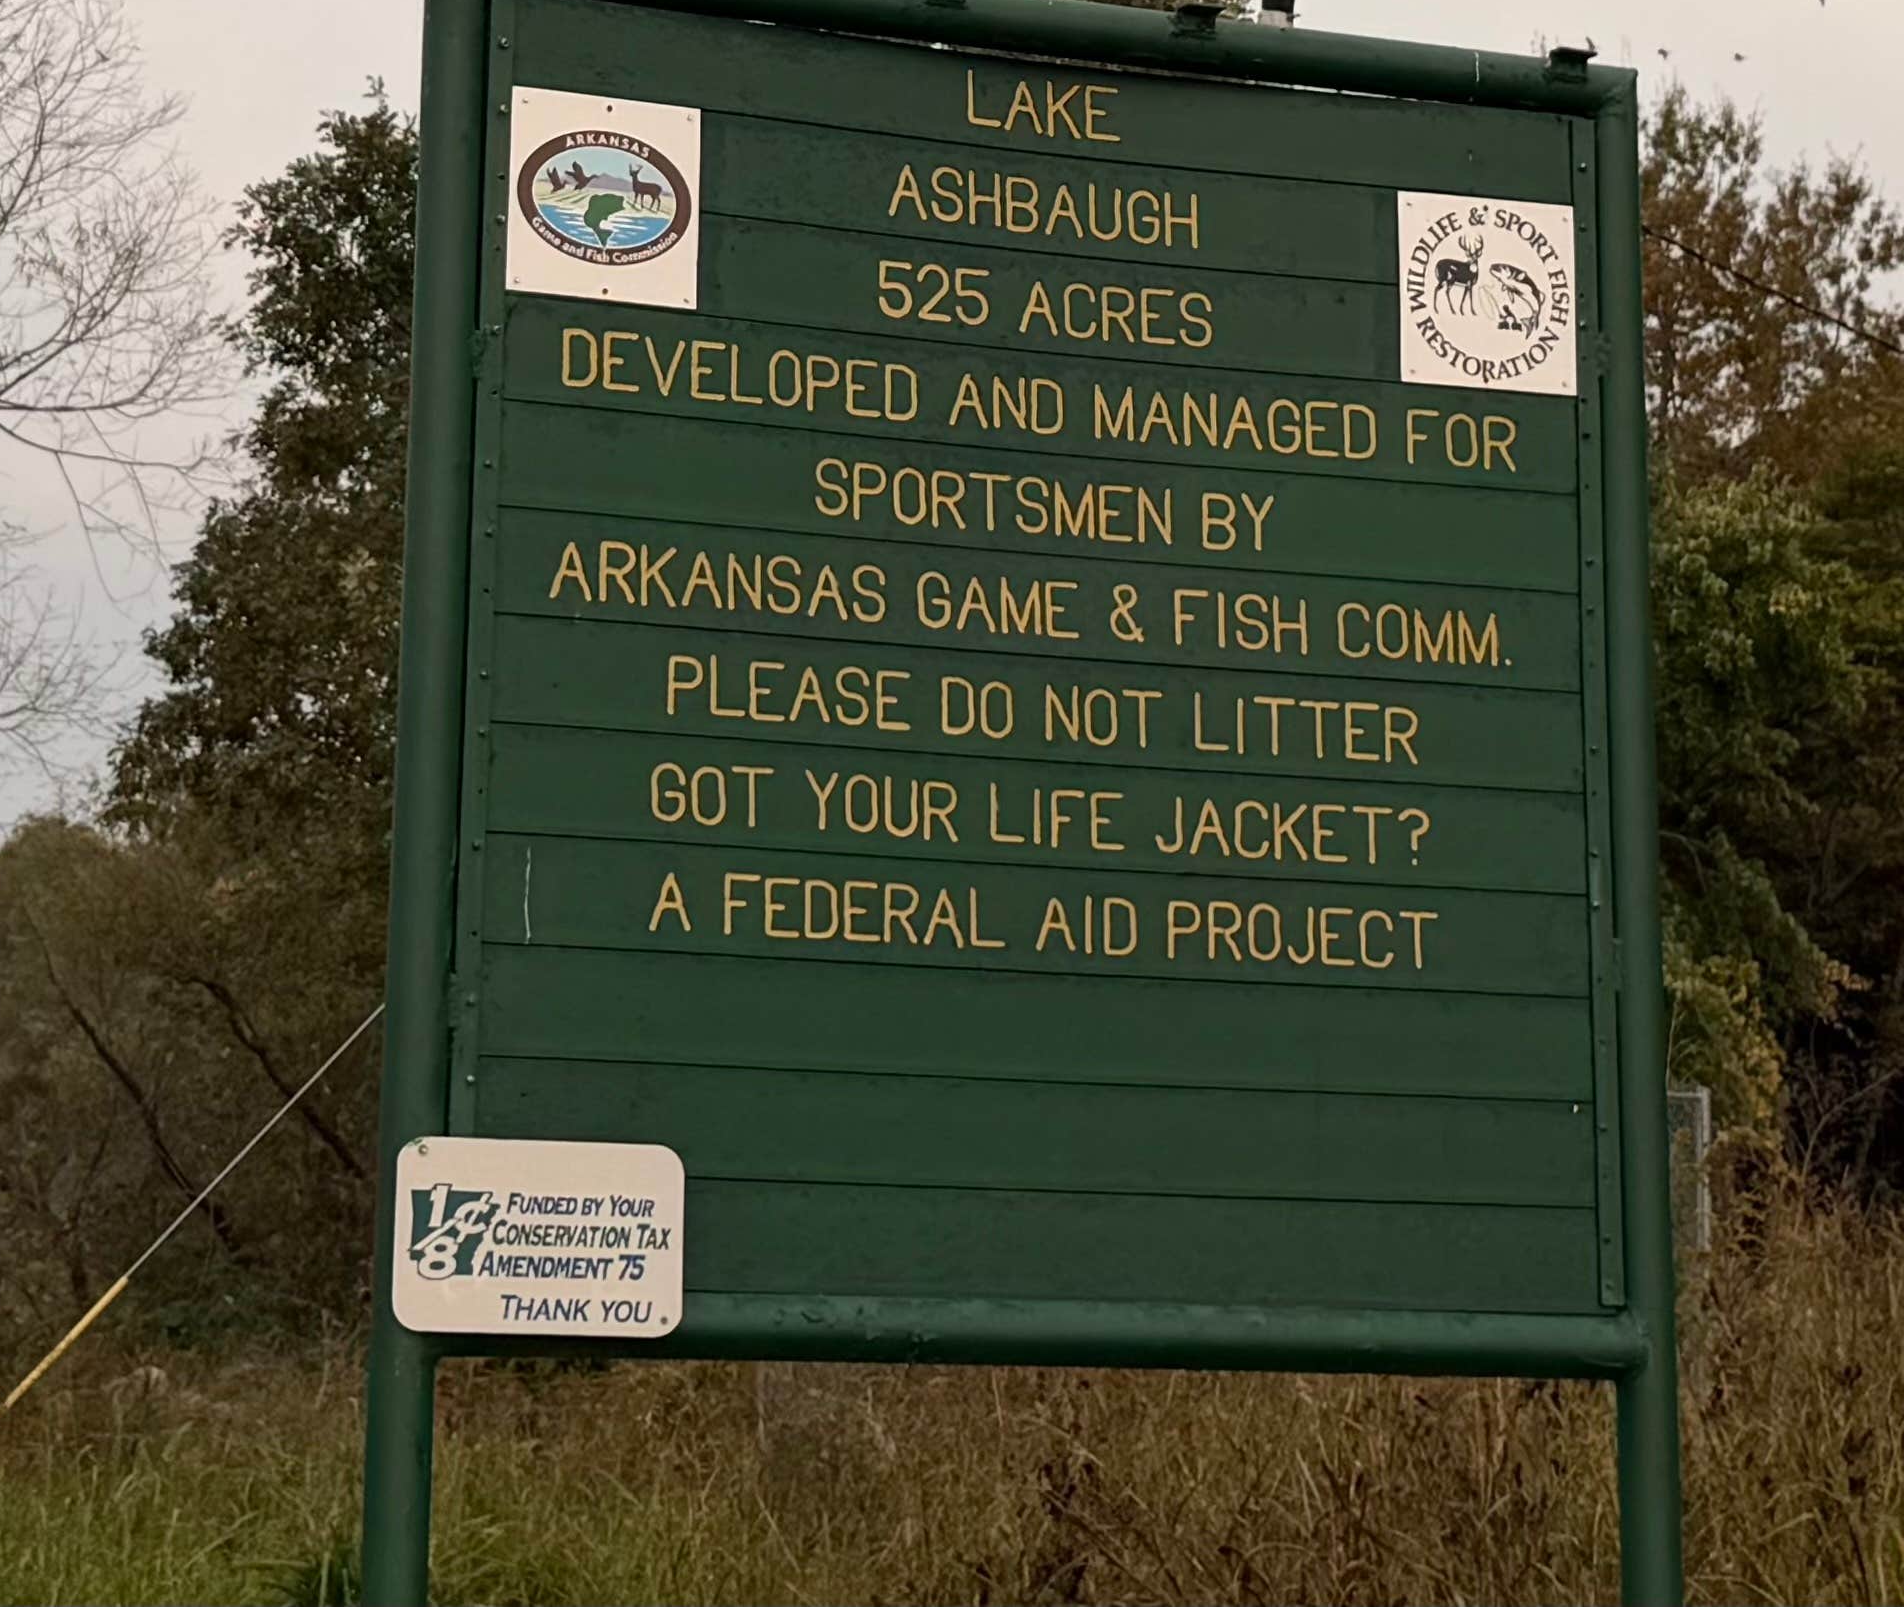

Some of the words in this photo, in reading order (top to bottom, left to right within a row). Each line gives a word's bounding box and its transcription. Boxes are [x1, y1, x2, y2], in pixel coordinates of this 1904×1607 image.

[565, 132, 650, 158] ARKANSAS
[968, 71, 1120, 142] LAKE
[531, 216, 562, 246] Game
[561, 241, 584, 258] and
[586, 247, 610, 263] Fish
[612, 232, 678, 263] Commission
[890, 166, 1198, 249] ASHBAUGH
[1468, 207, 1485, 226] &
[1494, 209, 1558, 264] SPORT
[1407, 212, 1462, 313] WILDLIFE
[1548, 269, 1570, 326] FISH
[879, 261, 990, 326] 525
[1021, 282, 1213, 348] ACRES
[1416, 316, 1559, 380] RESTORATION
[563, 329, 918, 422] DEVELOPED
[951, 374, 1064, 435] AND
[1095, 386, 1377, 460] MANAGED
[1408, 410, 1516, 473] FOR
[815, 457, 1172, 545] SPORTSMEN
[1202, 492, 1274, 551] BY
[550, 541, 886, 623] ARKANSAS
[917, 572, 1080, 639] GAME
[1110, 585, 1145, 653] &
[1174, 589, 1308, 655] FISH
[1338, 604, 1513, 668] COMM.
[667, 655, 909, 731] PLEASE
[941, 677, 1013, 739] DO
[1045, 686, 1163, 747] NOT
[1194, 694, 1418, 764] LITTER
[651, 762, 774, 827] GOT
[806, 772, 957, 840] YOUR
[990, 781, 1125, 851] LIFE
[1156, 800, 1430, 864] JACKET?
[651, 874, 691, 931] A
[724, 872, 1006, 948] FEDERAL
[1036, 897, 1138, 956] AID
[1167, 900, 1436, 968] PROJECT
[618, 1254, 646, 1280] 75
[500, 1294, 591, 1322] THANK
[601, 1300, 653, 1323] YOU
